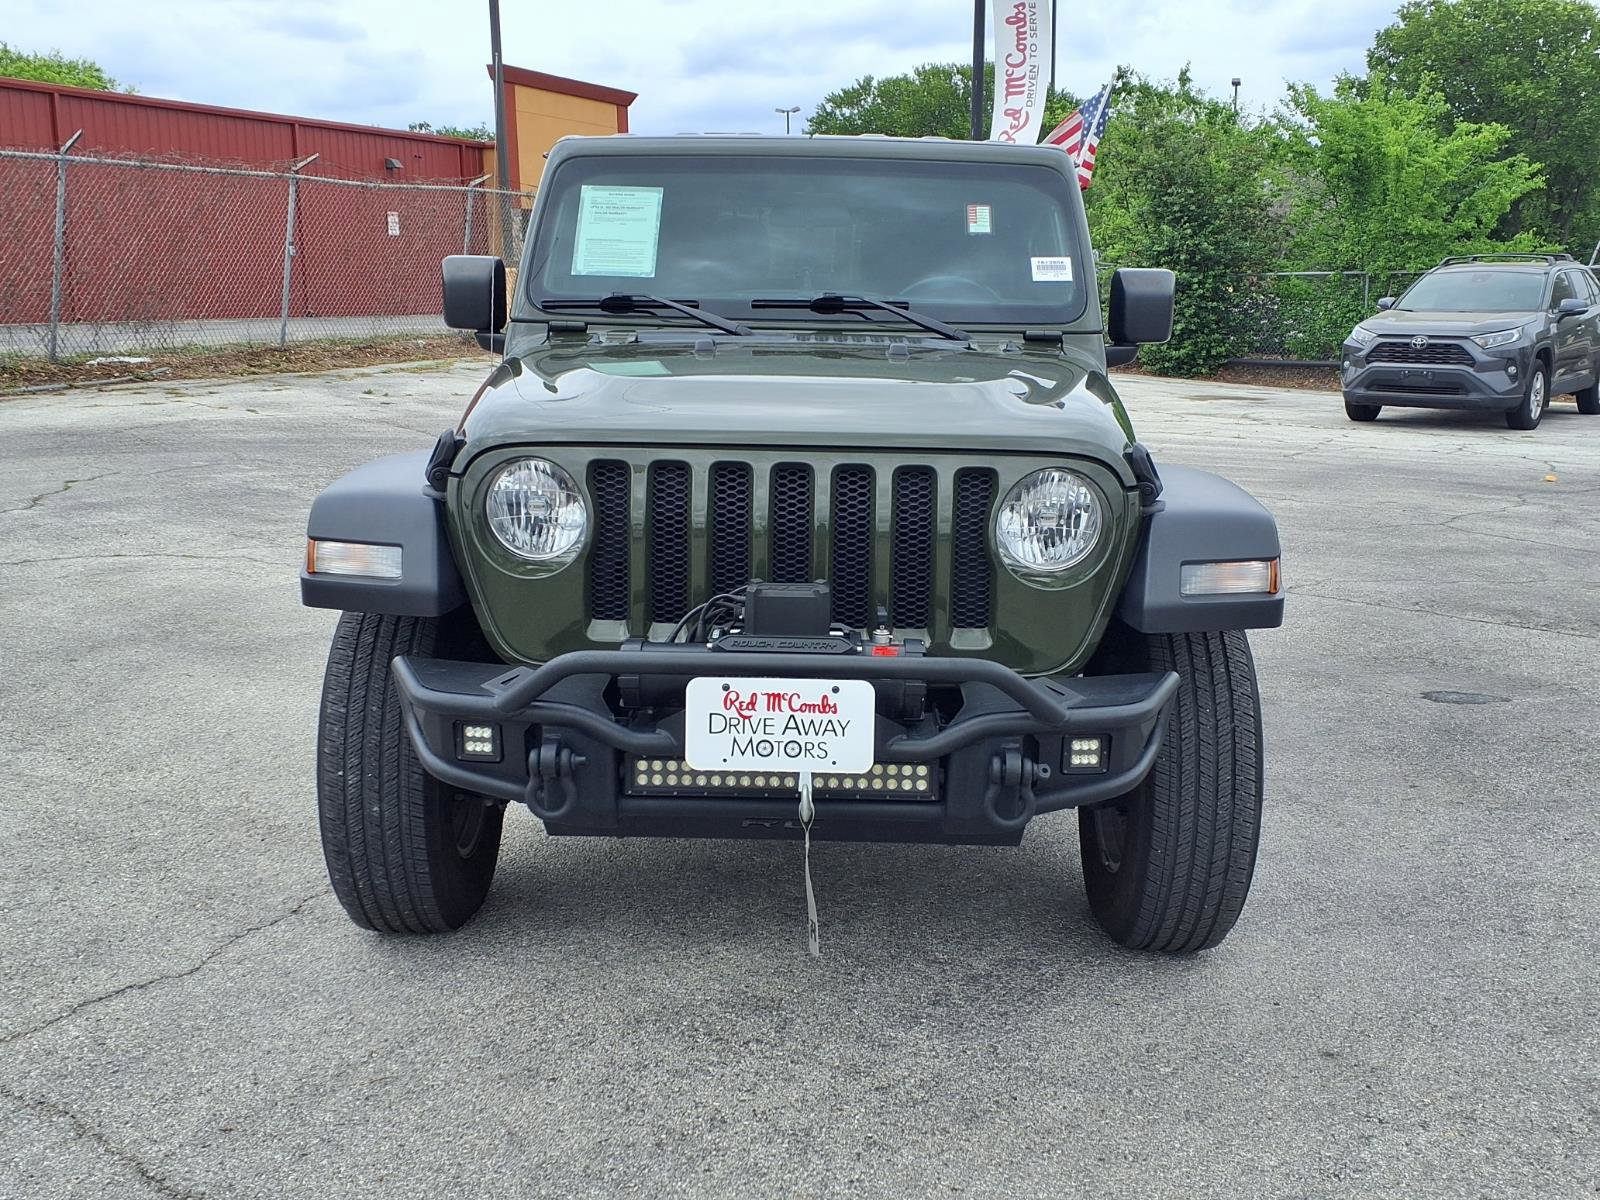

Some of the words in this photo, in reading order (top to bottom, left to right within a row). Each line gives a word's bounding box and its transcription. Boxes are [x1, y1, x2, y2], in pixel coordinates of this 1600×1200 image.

[1028, 1, 1038, 38] SERVE
[1003, 1, 1028, 105] McCombs
[1029, 43, 1038, 59] TO
[1026, 64, 1037, 108] DRIVEN
[998, 106, 1030, 144] Red
[730, 639, 775, 648] ROUGH
[777, 640, 838, 650] COUNTRY
[723, 690, 758, 719] Red
[761, 692, 838, 714] McCombs
[709, 712, 776, 735] DRIVE
[781, 714, 851, 737] AWAY
[731, 736, 829, 759] MOTORS
